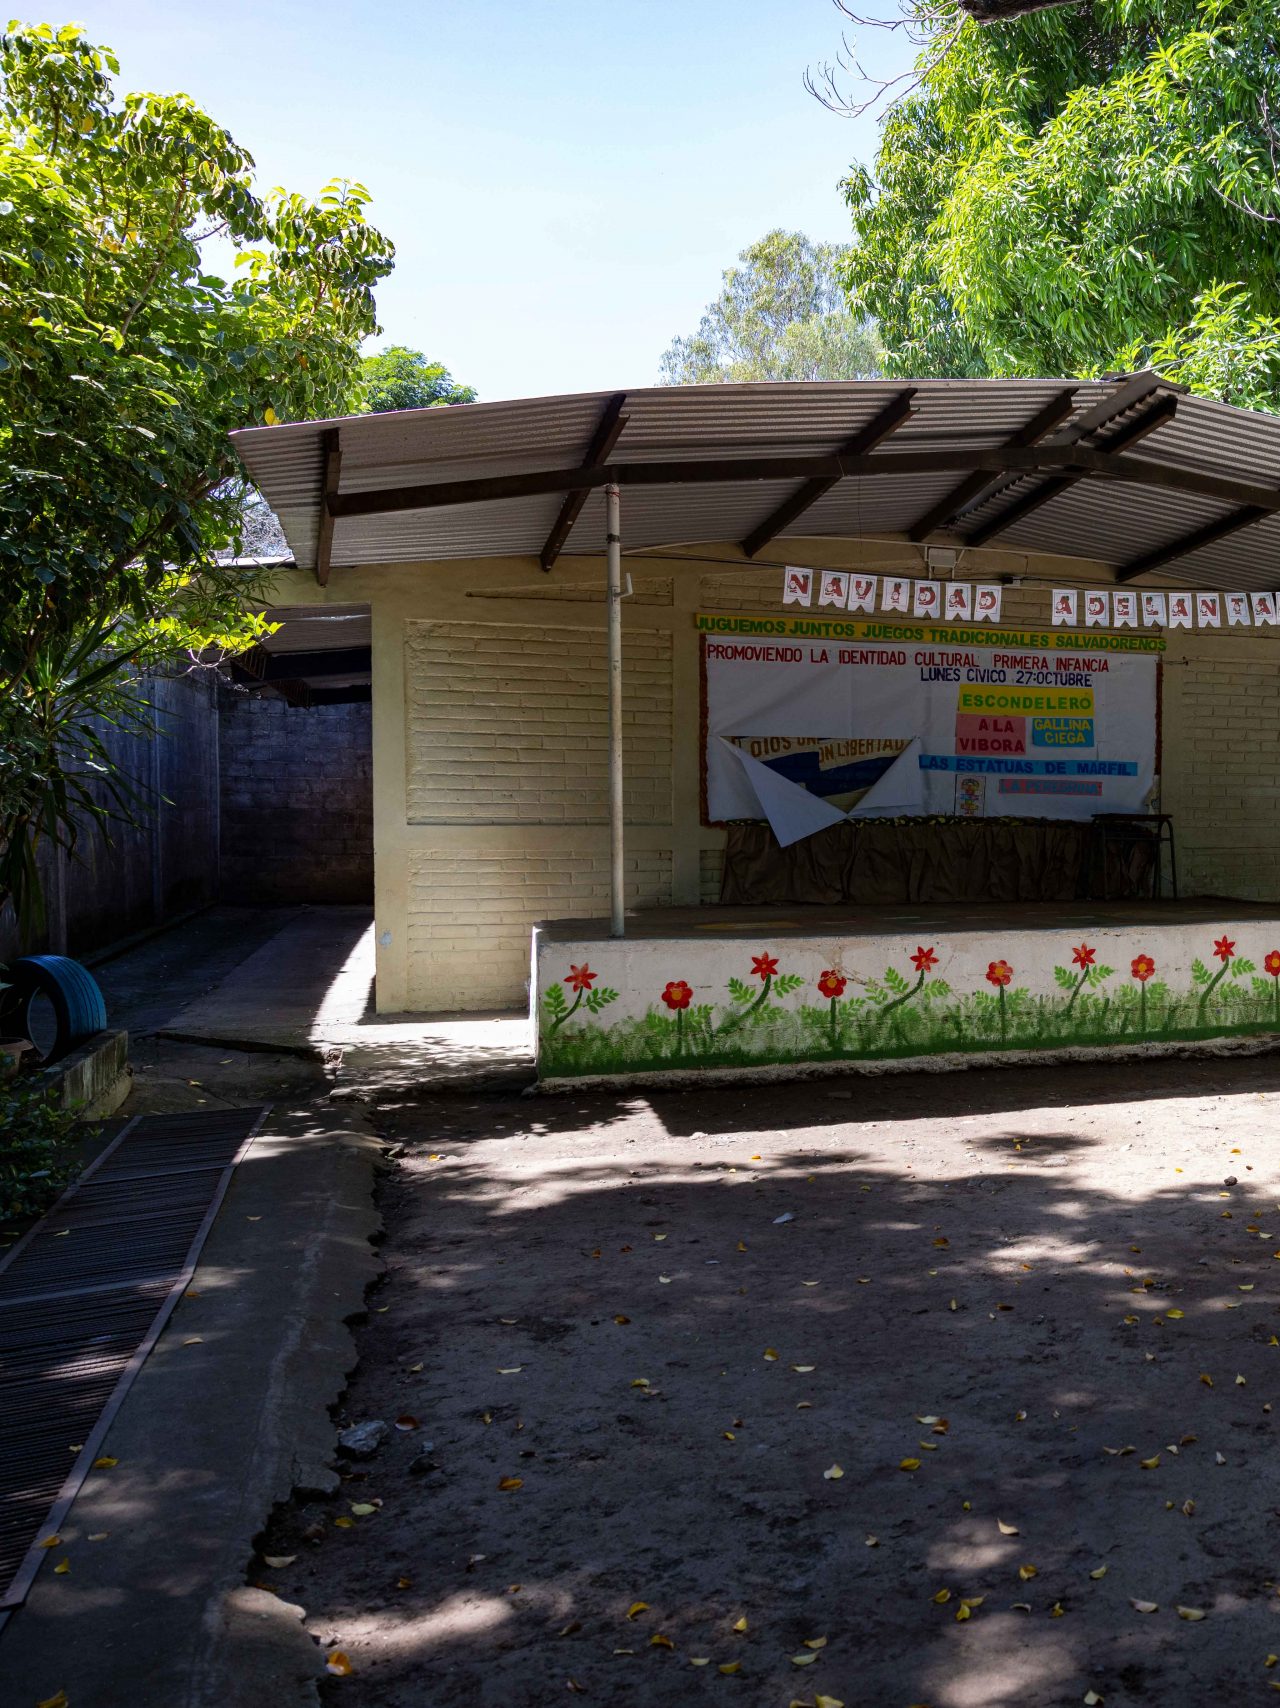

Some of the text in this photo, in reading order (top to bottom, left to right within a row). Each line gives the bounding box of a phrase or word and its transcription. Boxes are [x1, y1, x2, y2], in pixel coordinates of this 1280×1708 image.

[788, 574, 997, 610] NAVIDAD
[695, 616, 786, 634] JUGUEMOS
[789, 620, 855, 638] JUNTOS
[862, 624, 924, 641] JUEGOS
[929, 628, 1049, 647] TRADICIONALES
[707, 644, 1110, 672] PROMOVIENDO LA IDENTIDAD CULTURAL PRIMERA INFANCIA
[920, 667, 961, 682] LUNES
[962, 693, 1092, 710] ESCONDELERO
[978, 718, 1014, 733] A LA
[1033, 718, 1092, 732] GALLINA
[959, 737, 1025, 752] VIBORA
[1044, 731, 1086, 744] CIEGA
[919, 755, 1132, 776] LAS ESTATUAS DE MARFIL
